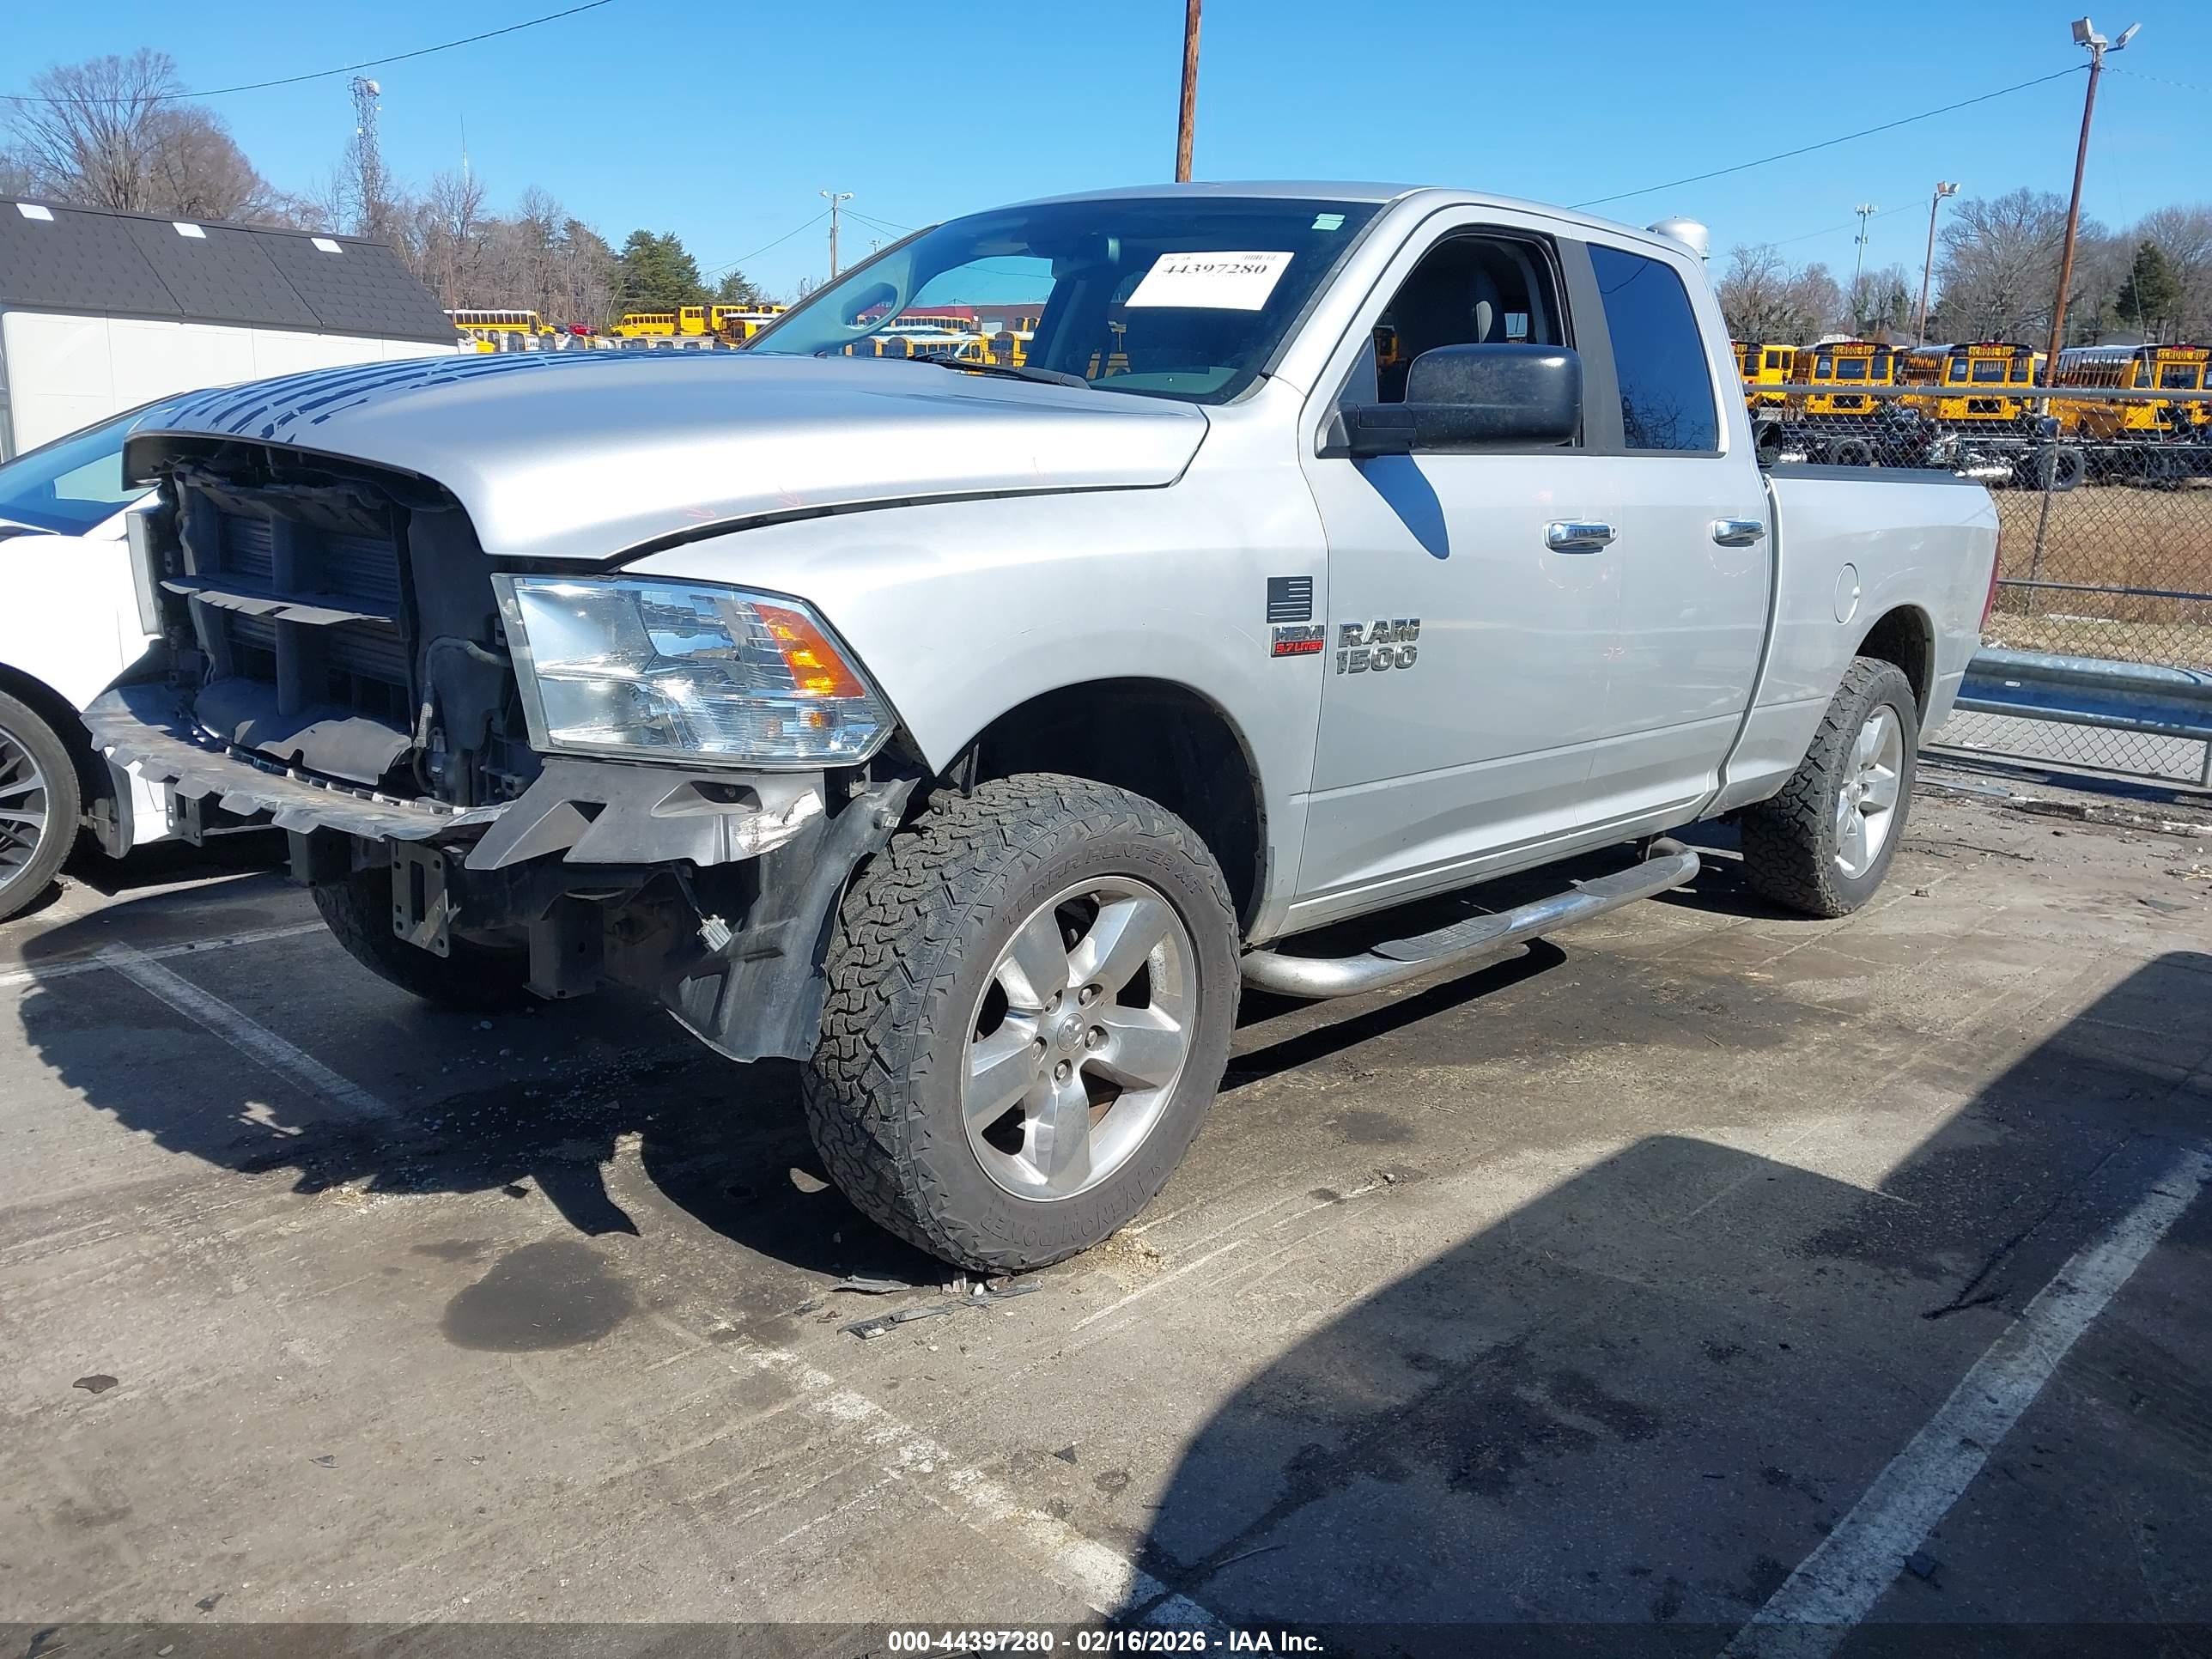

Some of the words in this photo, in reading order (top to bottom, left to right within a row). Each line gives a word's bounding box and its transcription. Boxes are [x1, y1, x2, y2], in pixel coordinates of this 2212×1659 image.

[1163, 264, 1268, 275] 44397280
[1833, 345, 1858, 356] SCHOOL
[1862, 345, 1875, 356] BUS
[1970, 346, 1996, 357] SCHOOL
[2000, 346, 2014, 357] BUS
[2159, 349, 2189, 360] SCHOOL
[2192, 349, 2209, 360] BUS
[1275, 625, 1325, 641] HEMI
[1337, 618, 1421, 648] RAM
[1277, 641, 1294, 653] 5.7
[1295, 640, 1323, 652] LITER
[1336, 644, 1419, 675] 1500
[1085, 842, 1178, 872] HUNTER
